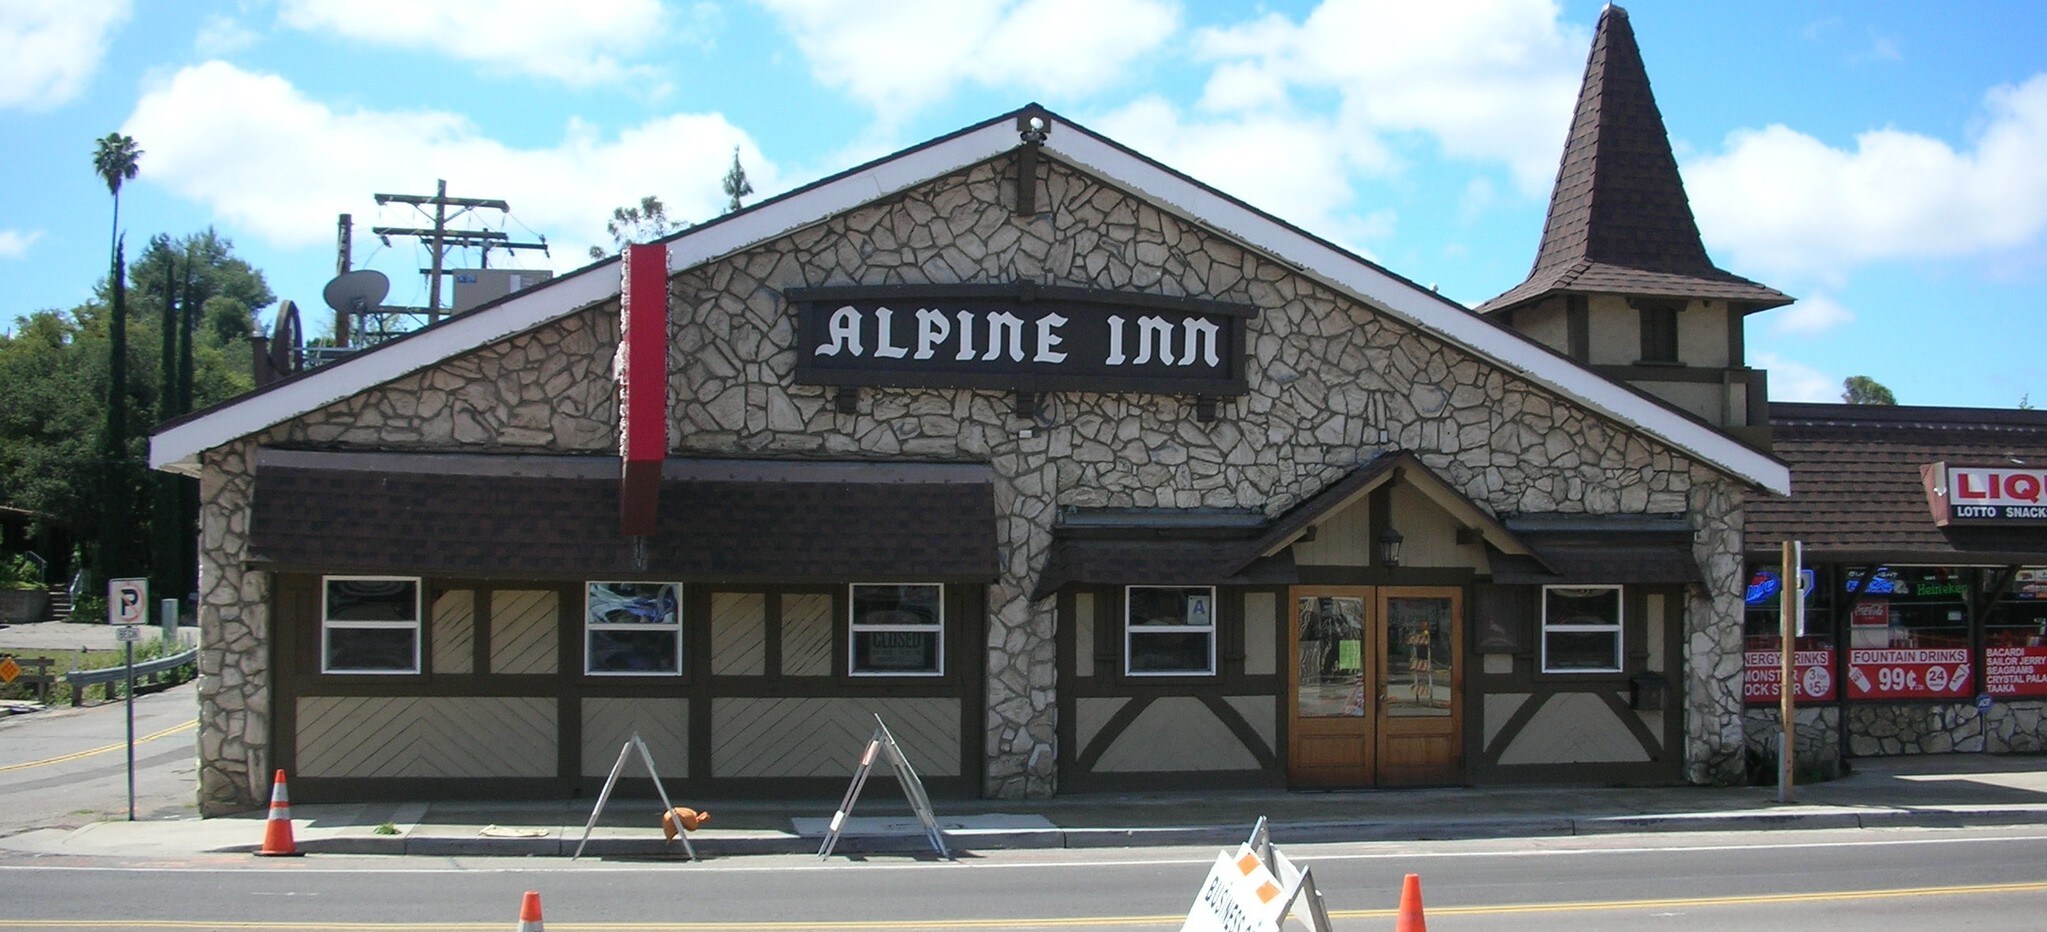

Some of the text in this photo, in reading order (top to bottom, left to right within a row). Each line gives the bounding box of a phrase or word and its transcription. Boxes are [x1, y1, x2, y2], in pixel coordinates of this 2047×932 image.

[815, 305, 1220, 368] ALPINE INN
[1957, 473, 2047, 504] LIQ
[1957, 506, 1997, 518] LOTTO
[1193, 599, 1205, 615] A
[1744, 652, 1826, 665] NERGY RINKS
[1853, 650, 1965, 662] FOUNTAIN DRINKS
[1986, 648, 2025, 657] BACARDI
[1986, 656, 2047, 666] SAILOR JERRY
[1744, 669, 1798, 682] MONSTR
[1809, 669, 1816, 681] 3
[1929, 670, 1945, 681] 24
[1986, 666, 2034, 675] SEAGRAMS
[1986, 675, 2024, 684] CRYSTAL
[1744, 682, 1802, 695] OCK SR
[1986, 684, 2016, 693] TAAKA
